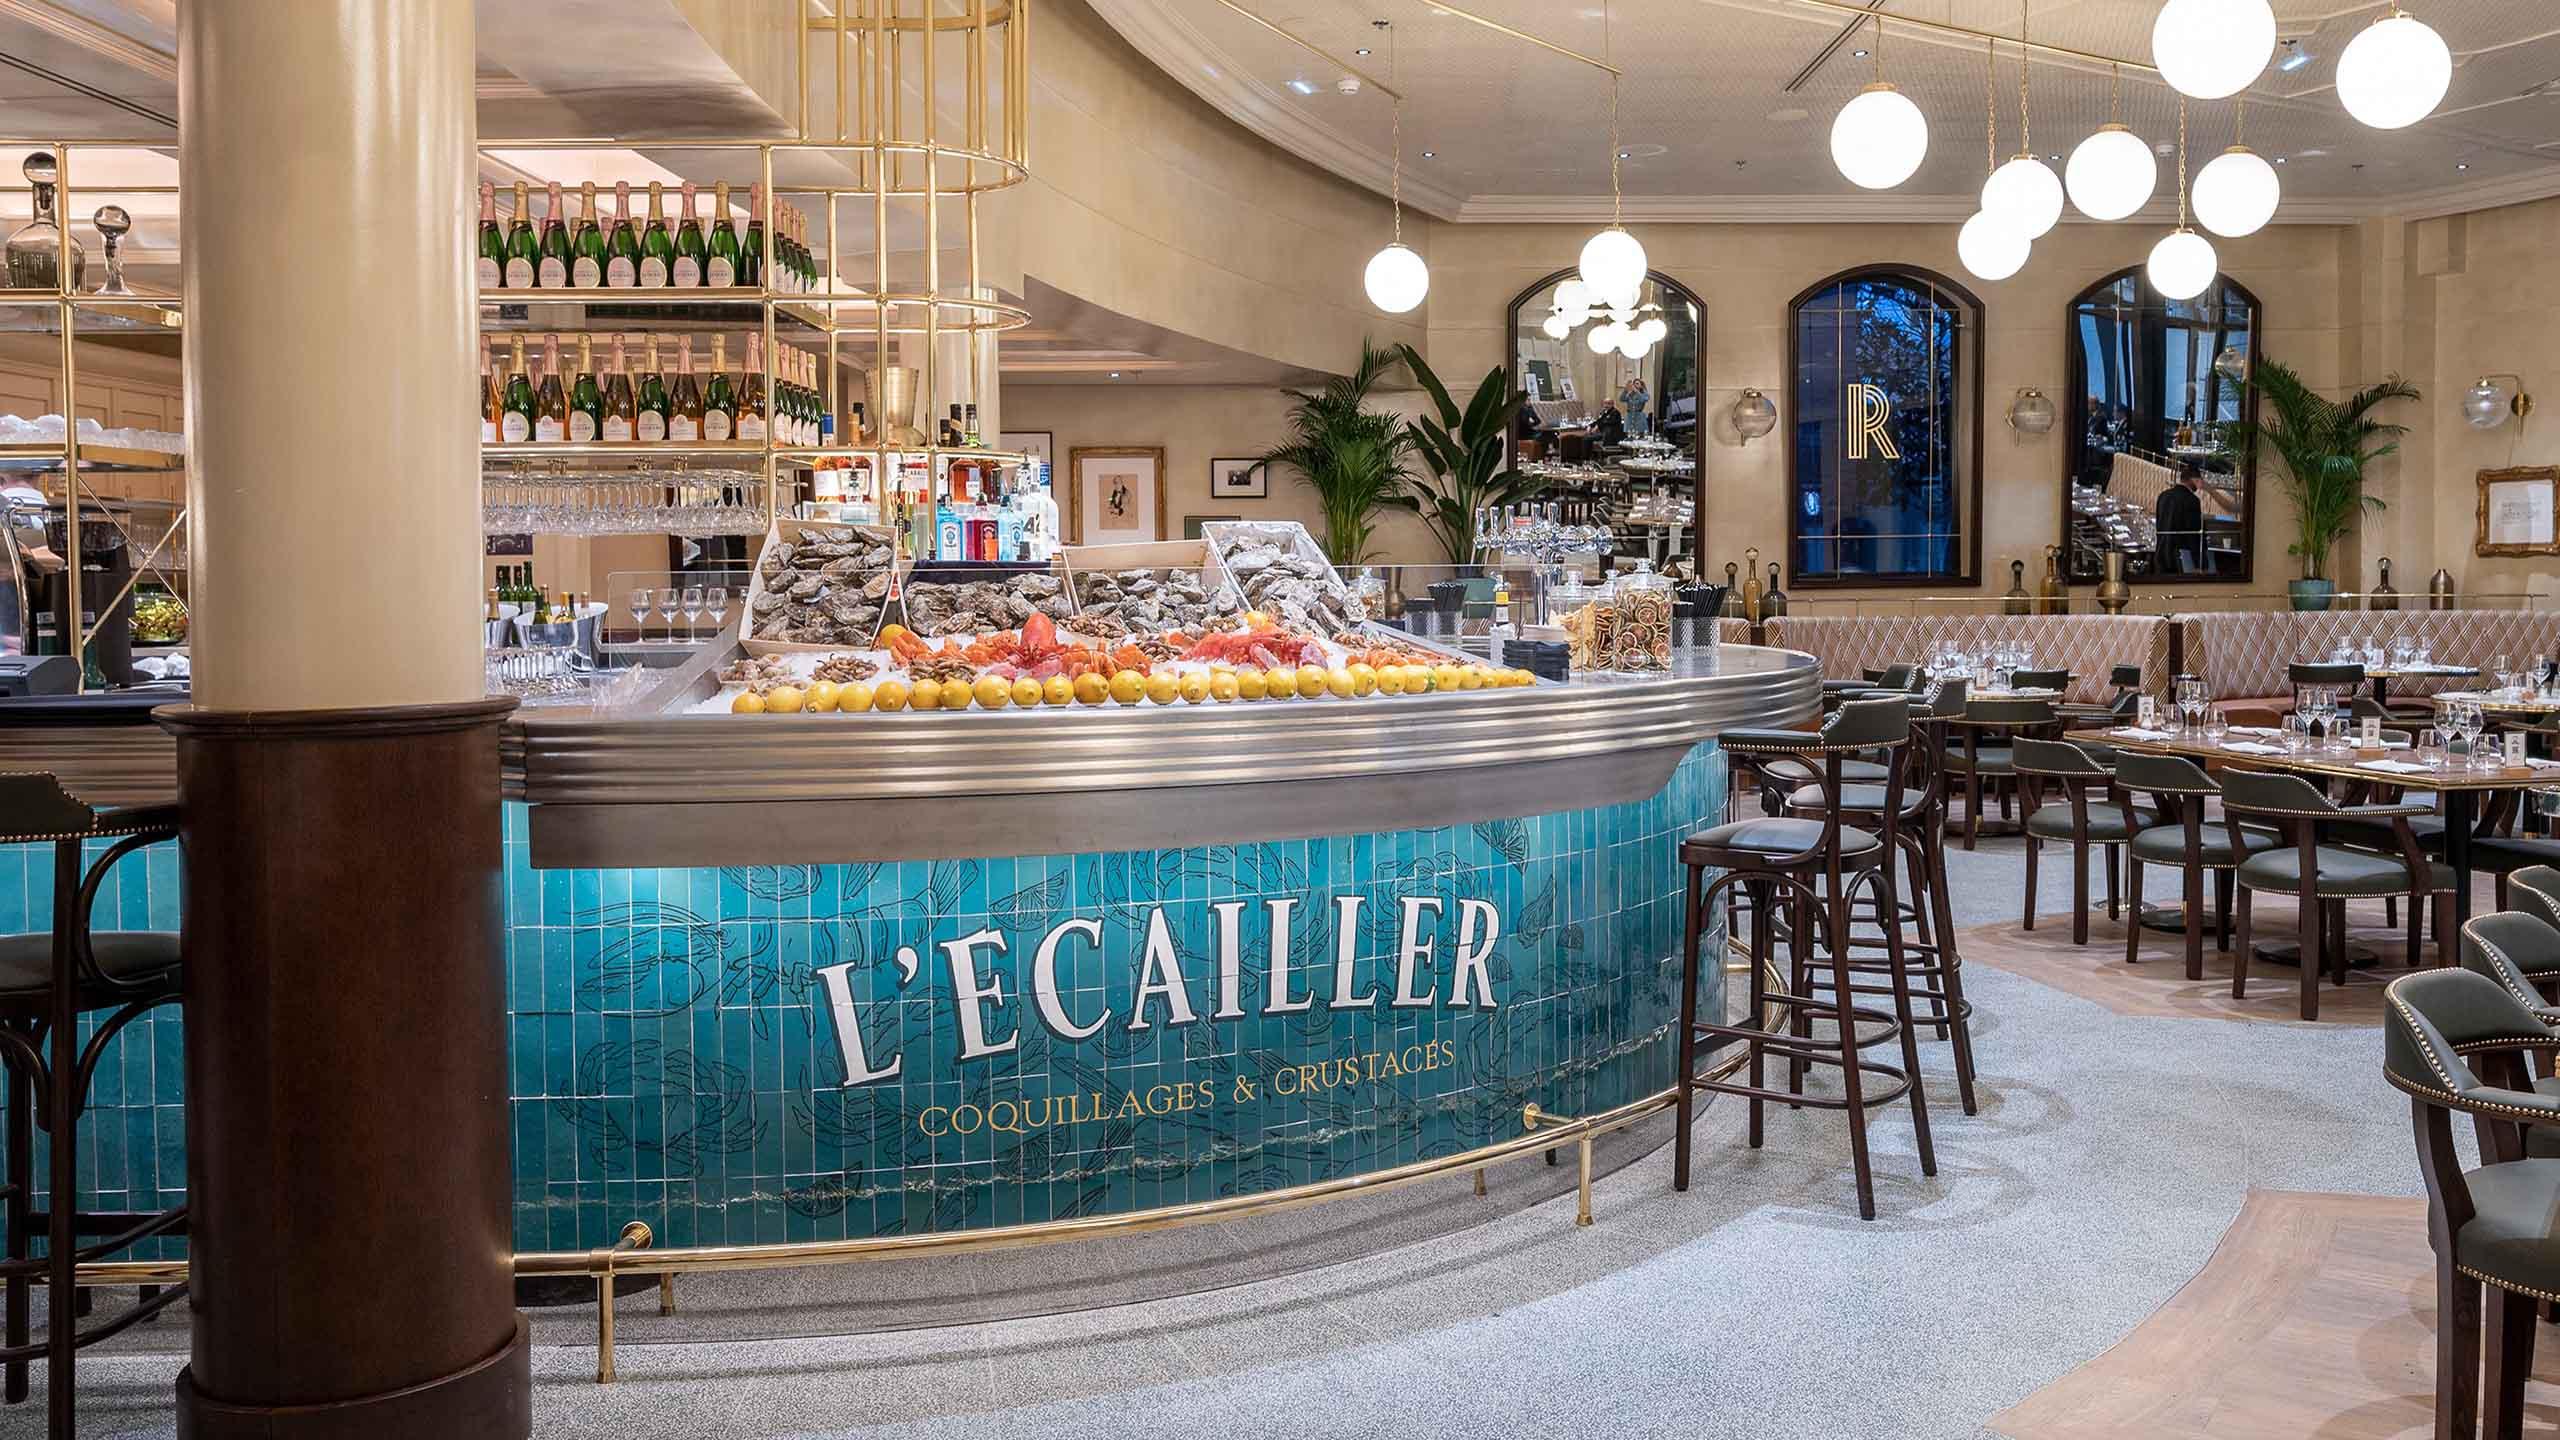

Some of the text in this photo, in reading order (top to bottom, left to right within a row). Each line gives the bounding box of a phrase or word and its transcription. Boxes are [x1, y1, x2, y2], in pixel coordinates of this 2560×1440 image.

[1847, 383, 1901, 460] R
[815, 895, 1502, 1087] L'ECAILLER
[917, 1039, 1457, 1138] COQUILLAGES & CRUSTACÉS
